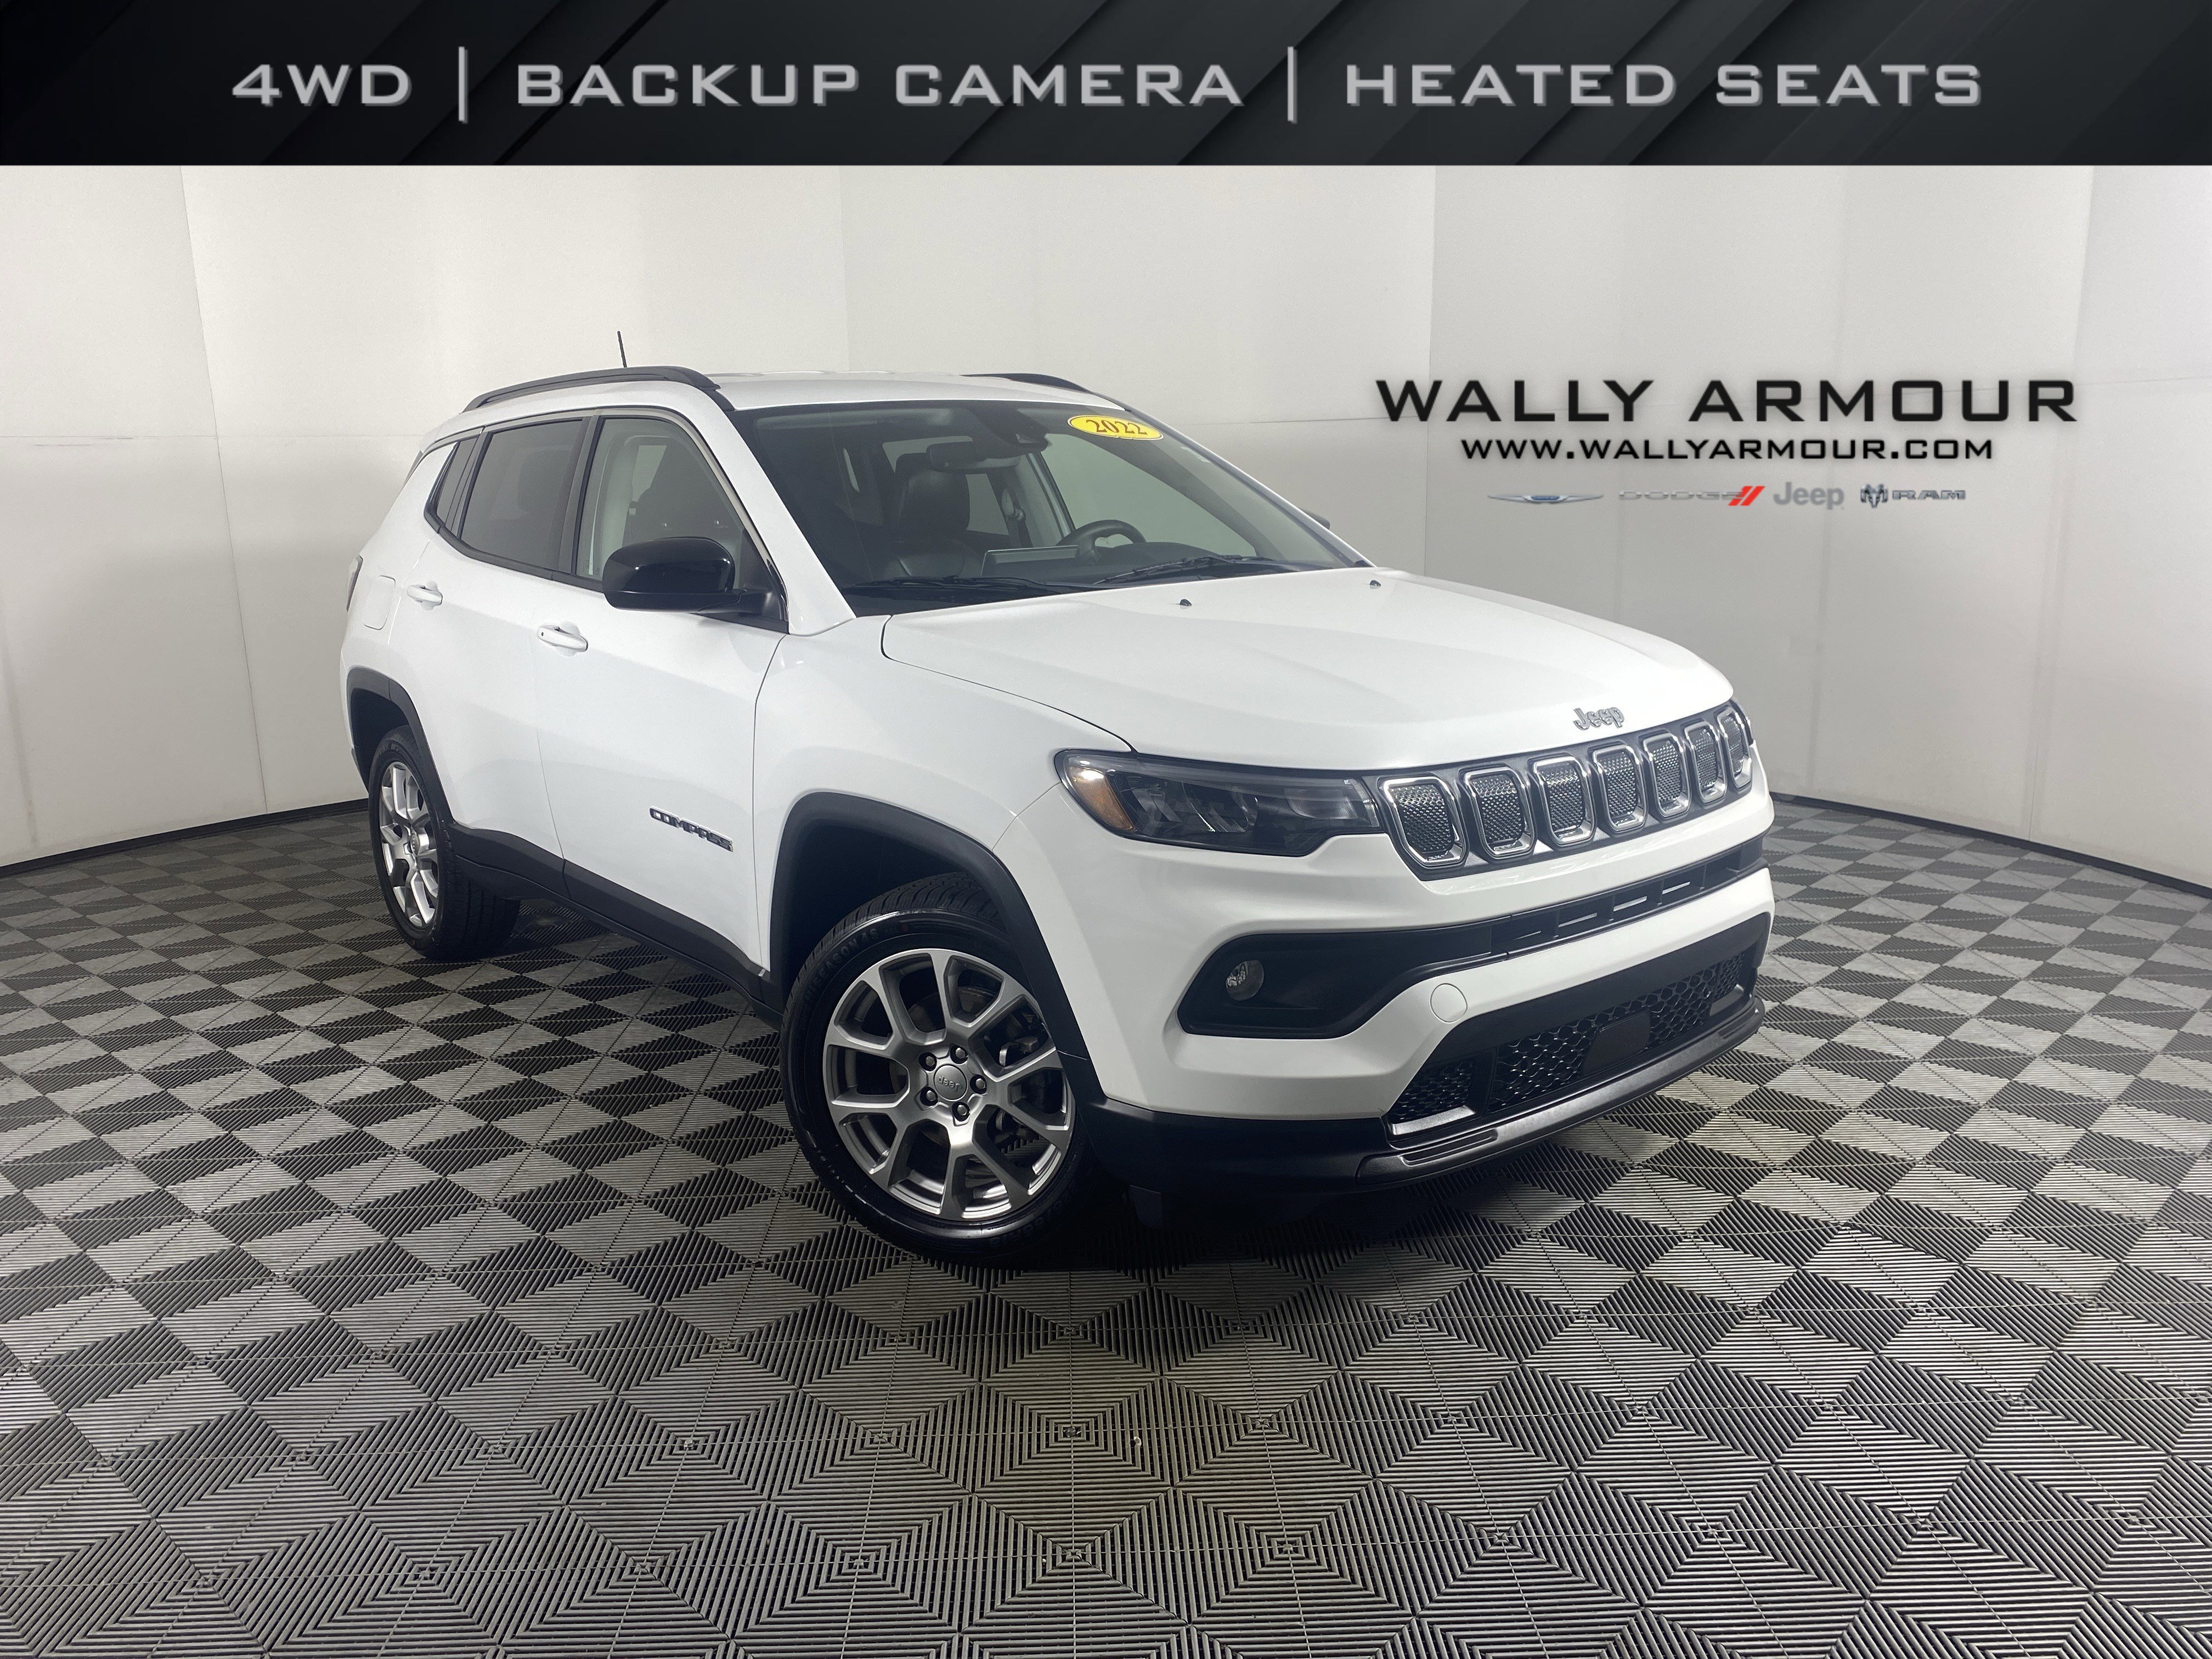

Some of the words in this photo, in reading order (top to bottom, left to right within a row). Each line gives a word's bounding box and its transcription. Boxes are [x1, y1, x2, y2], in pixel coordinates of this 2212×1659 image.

[1086, 419, 1148, 435] 2022
[1573, 707, 1625, 731] Jeep
[938, 1075, 963, 1092] Jeep
